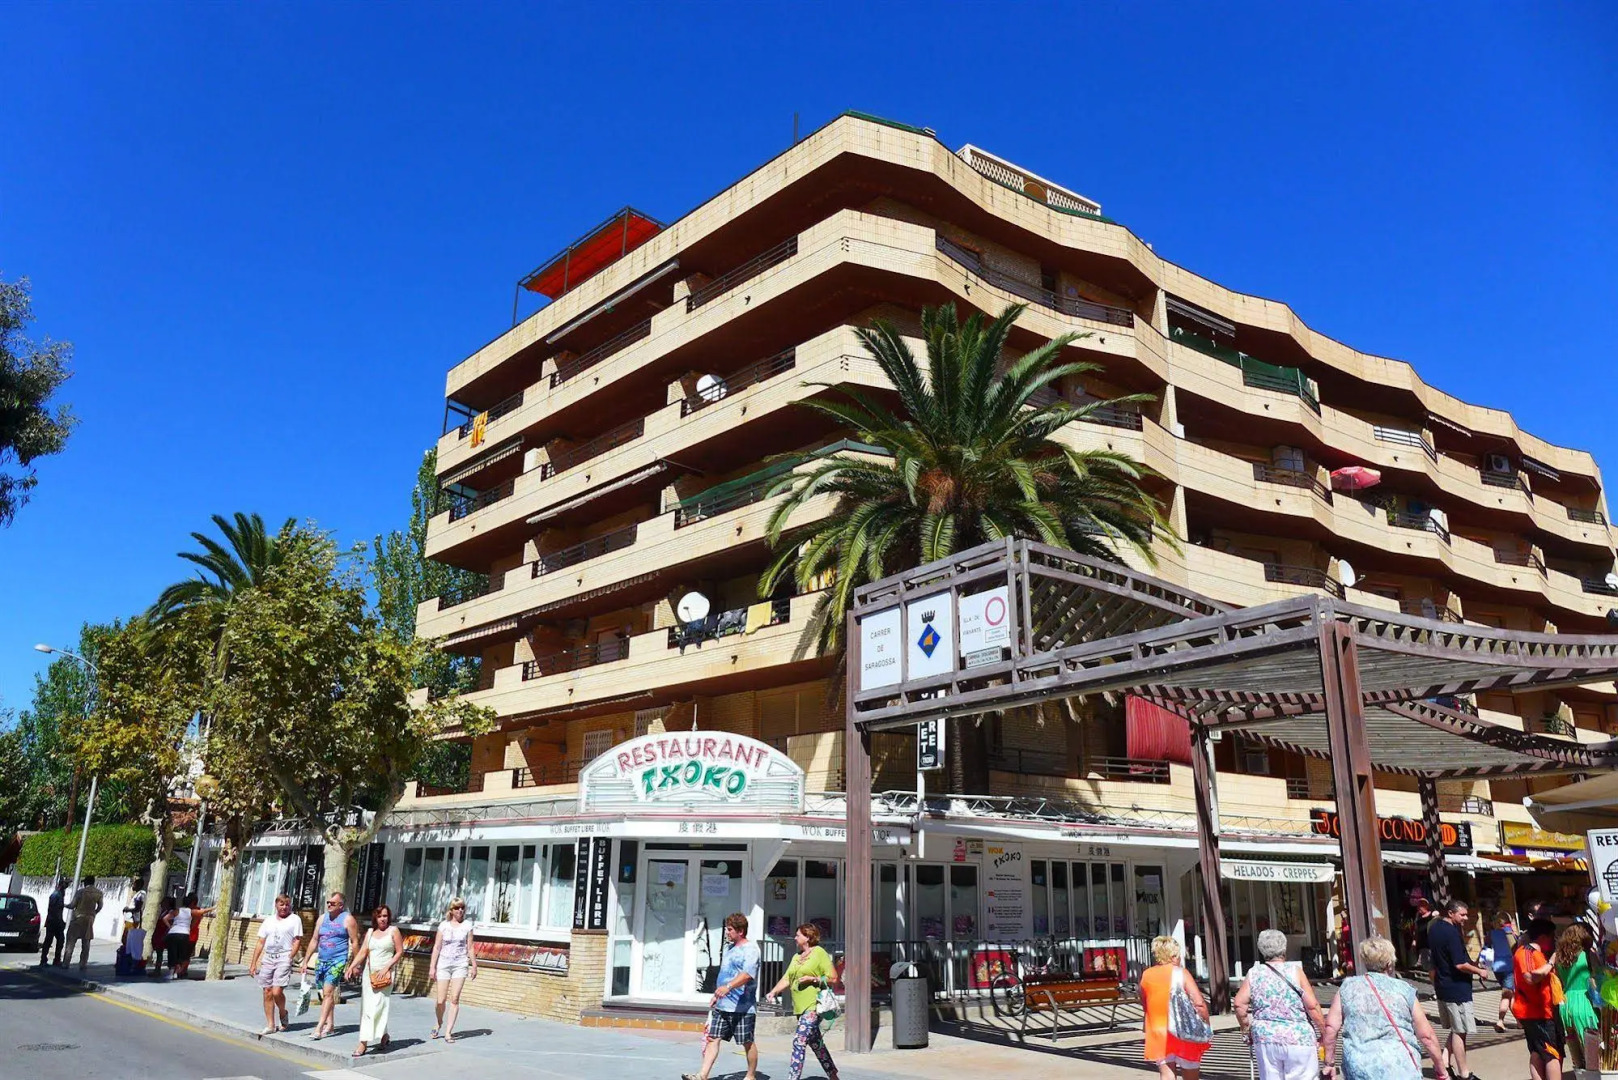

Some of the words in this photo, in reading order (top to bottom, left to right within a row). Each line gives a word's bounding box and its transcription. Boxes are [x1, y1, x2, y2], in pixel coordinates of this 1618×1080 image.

[870, 627, 891, 640] CARRER
[877, 644, 884, 653] DE
[864, 657, 896, 671] SARAGOSSA
[617, 738, 769, 773] RESTAURANT
[641, 760, 747, 797] TXOKO
[564, 825, 580, 834] BUFFET
[581, 824, 595, 833] LIBRE
[801, 825, 822, 837] WOK
[825, 828, 846, 838] BUFFE
[871, 829, 891, 842] WOK
[987, 846, 1004, 854] WOK
[597, 840, 607, 885] BUFFET
[993, 851, 1022, 869] TXOKO
[1233, 865, 1275, 878] HELADOS
[1282, 867, 1318, 880] CREPPES
[594, 887, 603, 926] LIBRE
